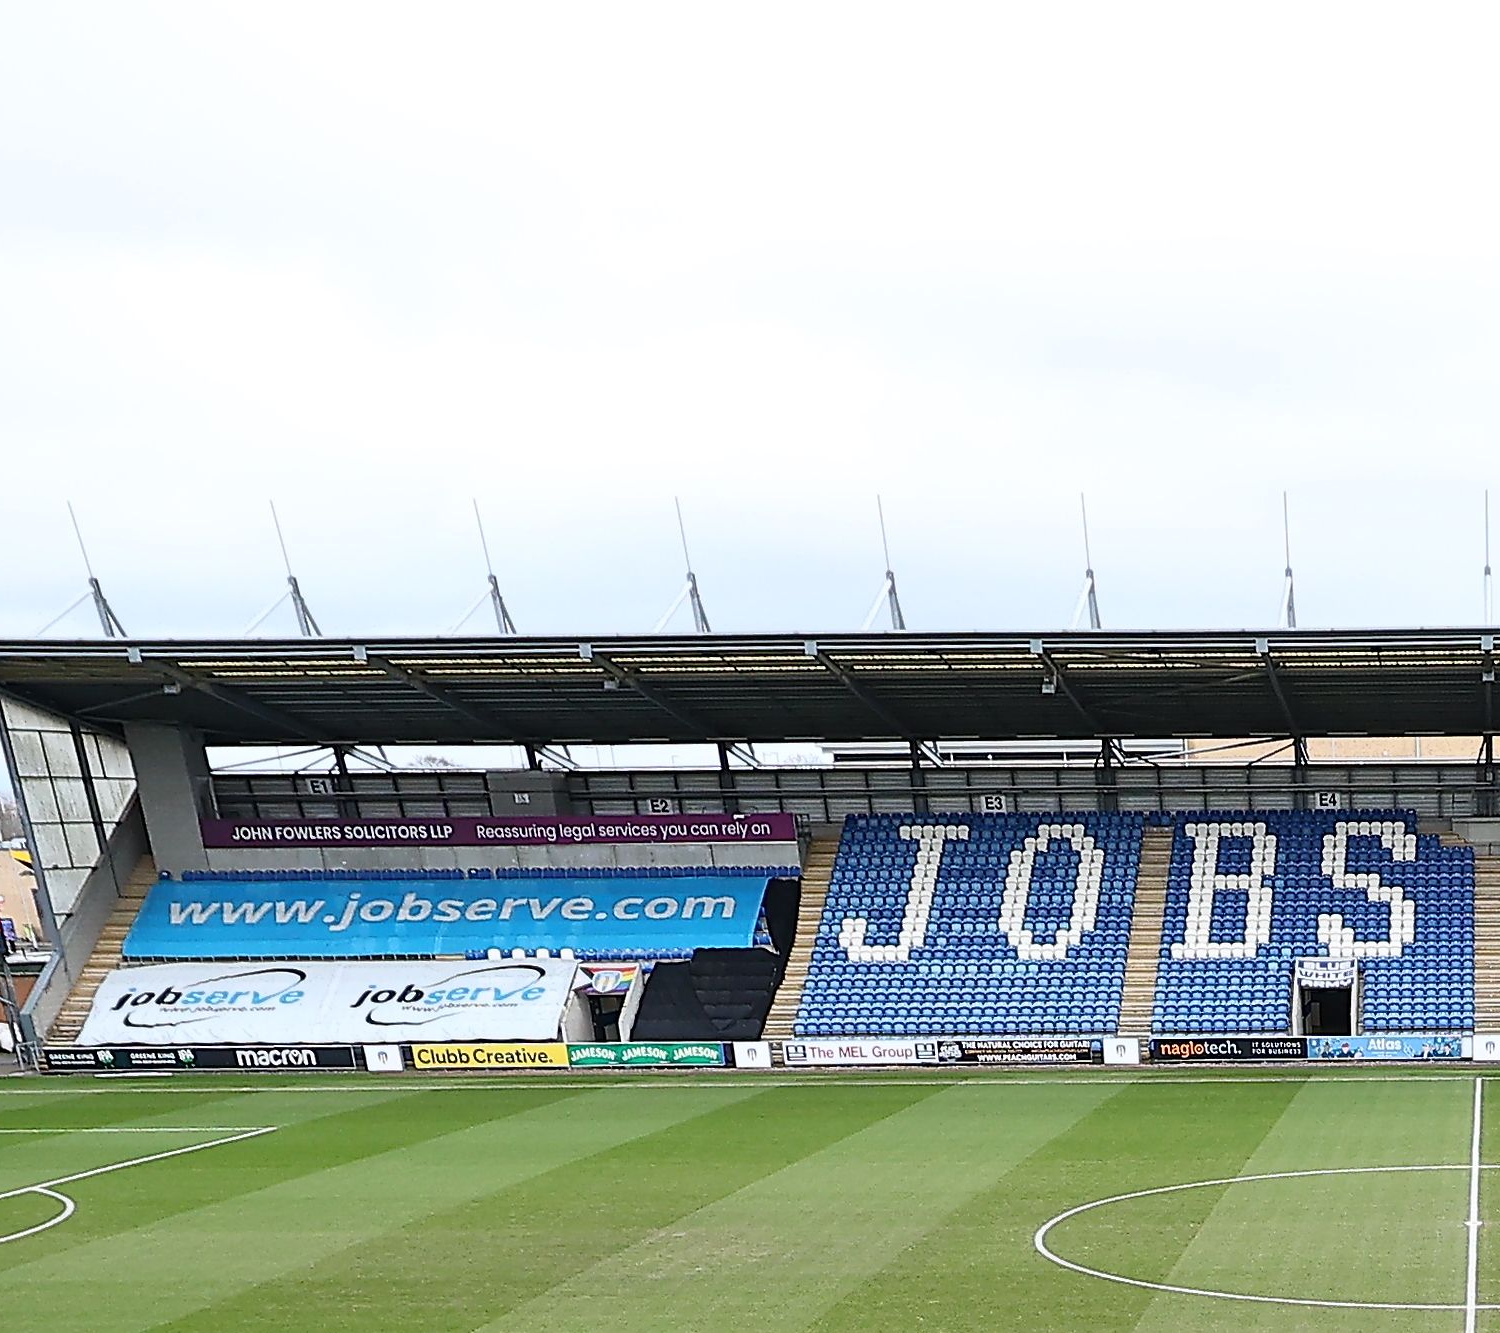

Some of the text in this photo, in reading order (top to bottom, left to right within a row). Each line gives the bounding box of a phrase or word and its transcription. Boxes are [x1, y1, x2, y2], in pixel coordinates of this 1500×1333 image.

[309, 780, 328, 793] E1
[650, 799, 670, 812] E2
[984, 795, 1004, 811] E3
[1319, 792, 1337, 807] E4
[231, 825, 453, 841] JOHN FOWLERS SOLICITORS LLP
[476, 822, 771, 842] Reassuring legal services you can rely on
[168, 891, 737, 933] www.jobserve.com
[1298, 969, 1354, 980] WHITE
[111, 986, 305, 1011] jobserve
[349, 980, 545, 1009] jobserve
[809, 1044, 913, 1061] The MEL Group
[962, 1041, 977, 1049] THE
[977, 1041, 1012, 1049] NATURAL
[1012, 1041, 1043, 1049] CHOICE
[1160, 1041, 1242, 1059] naglotech.
[1367, 1038, 1402, 1051] Atlas
[236, 1048, 317, 1068] macron
[417, 1046, 554, 1066] Clubb Creative.
[570, 1046, 617, 1063] JAMESON
[621, 1046, 669, 1062] JAMESON
[672, 1046, 719, 1062] JAMESON
